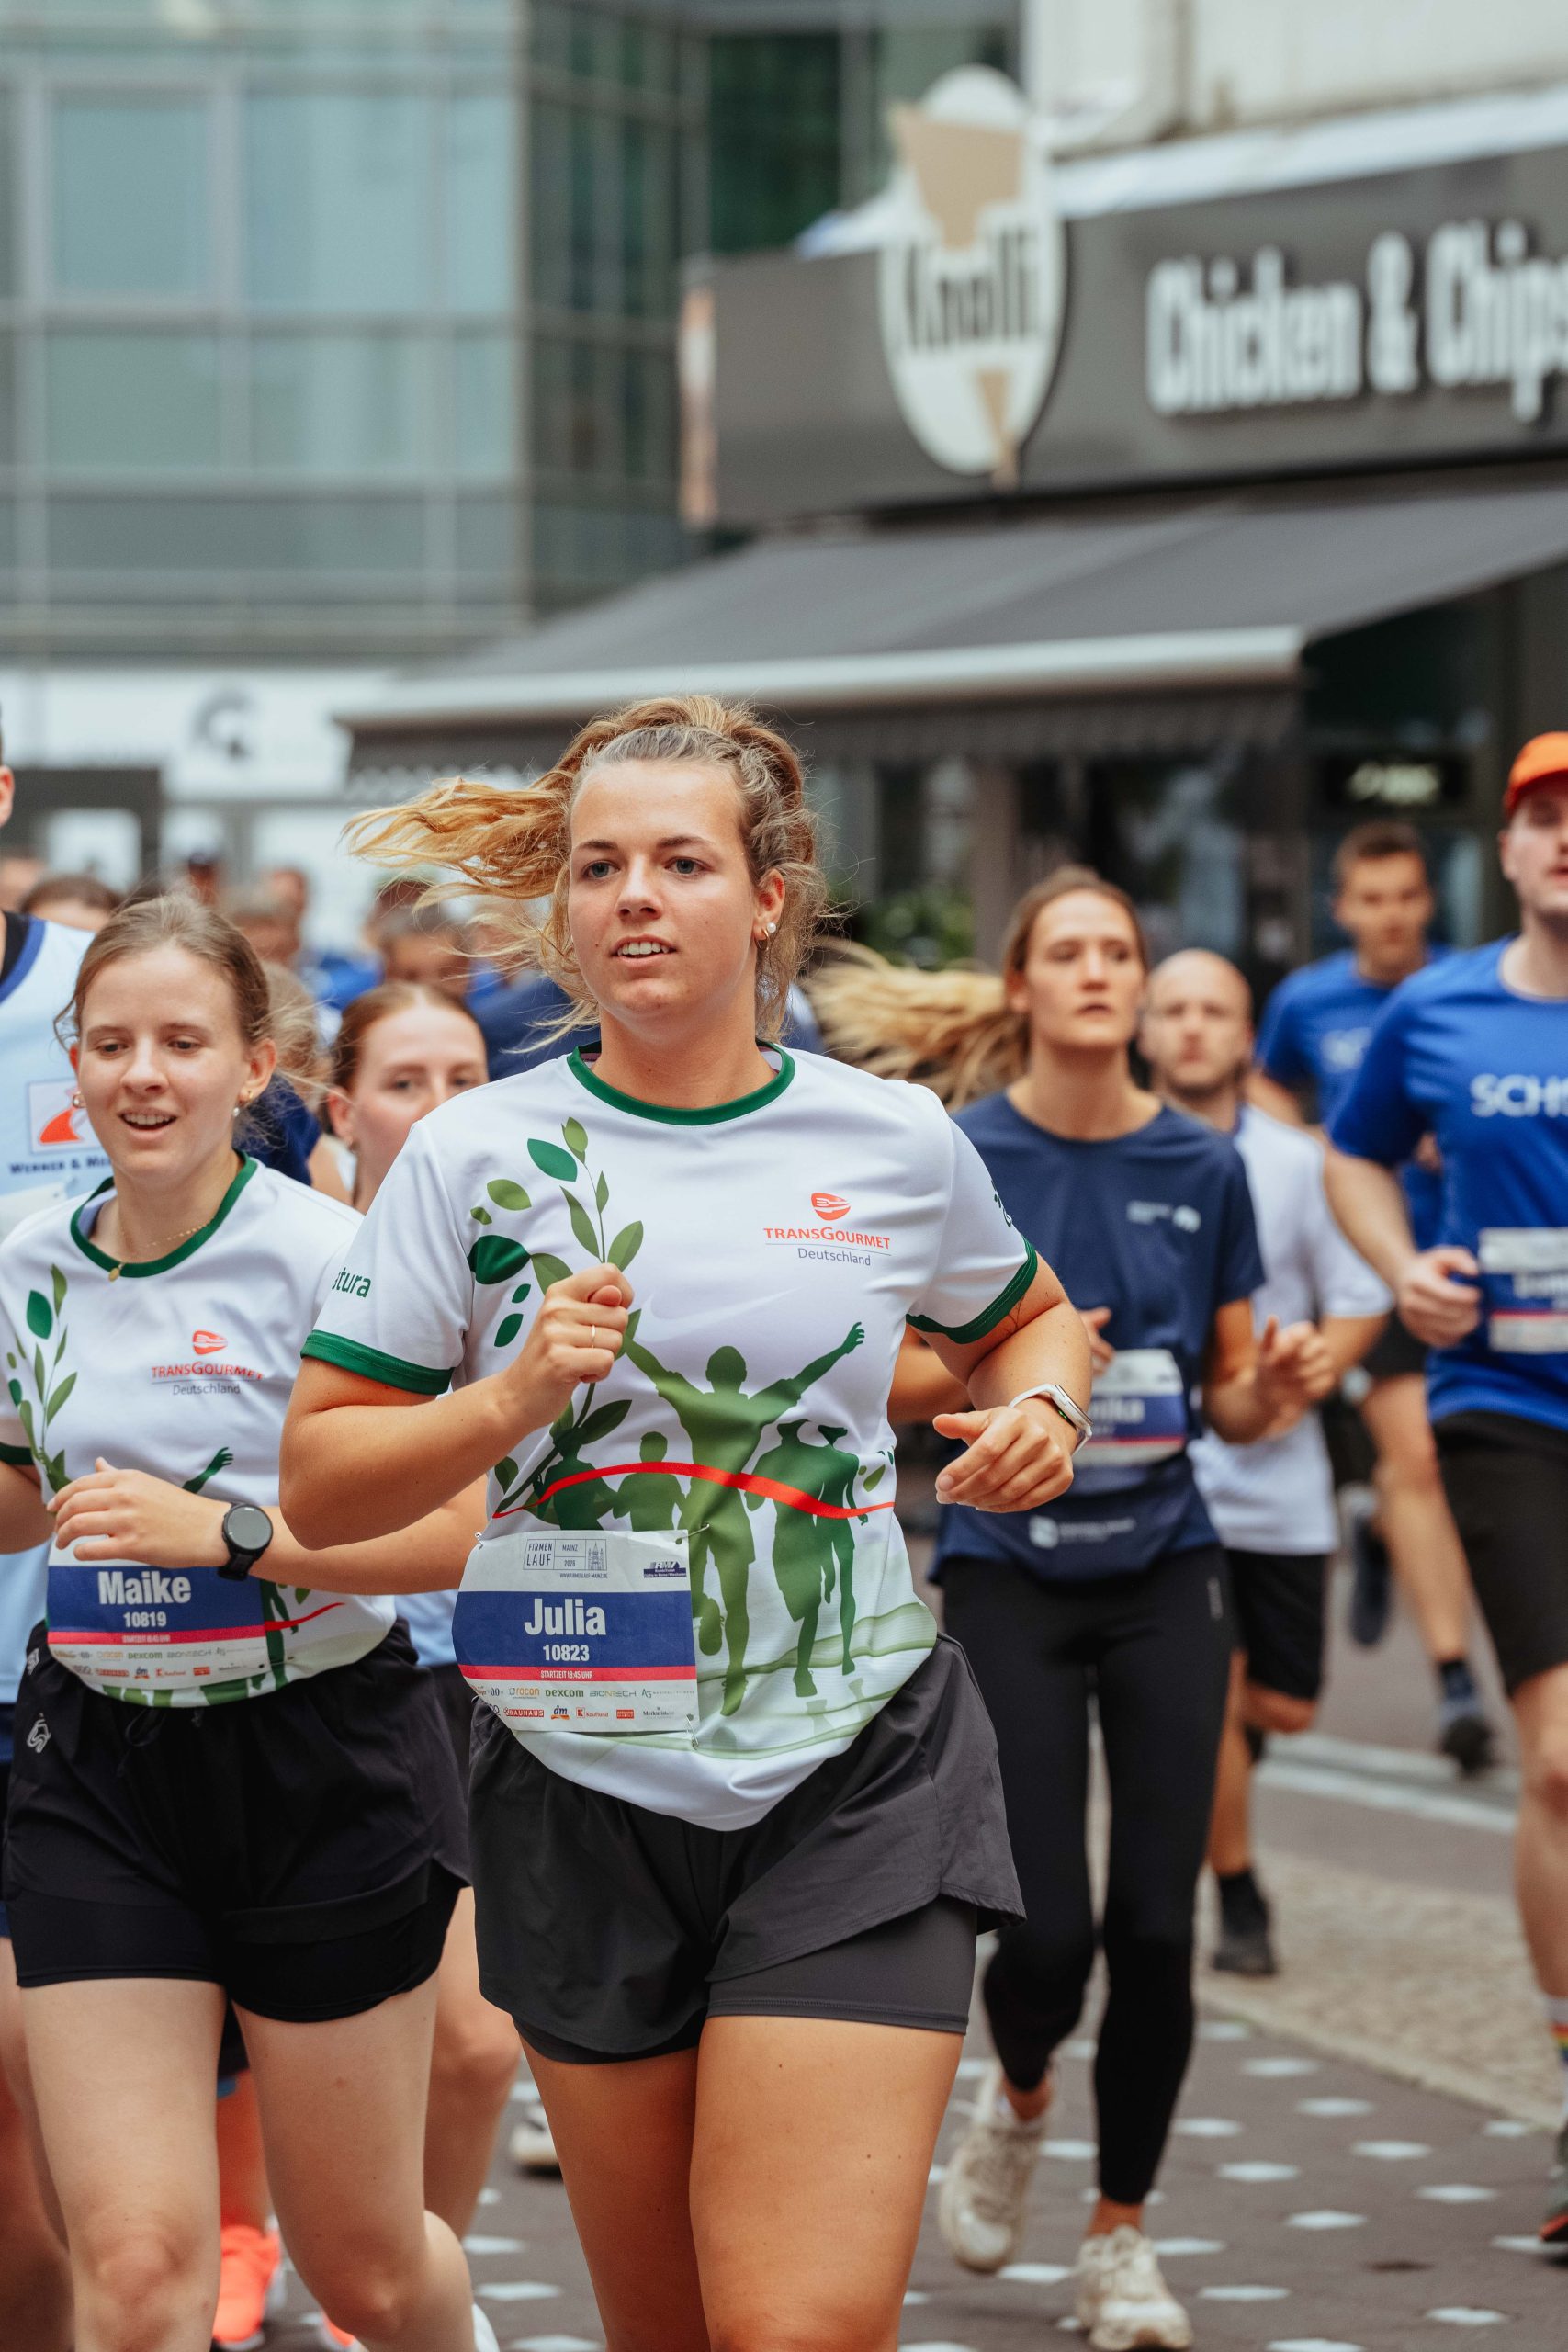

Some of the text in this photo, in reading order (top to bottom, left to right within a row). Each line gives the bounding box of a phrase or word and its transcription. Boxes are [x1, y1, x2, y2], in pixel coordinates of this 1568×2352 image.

[1147, 246, 1363, 415] Chicken
[1368, 230, 1418, 395] &
[1470, 1072, 1568, 1118] SCH
[71, 1157, 81, 1170] &
[797, 1247, 872, 1266] Deutschland
[173, 1382, 242, 1396] Deutschland
[527, 1543, 579, 1553] FIRMEN MAINZ
[526, 1553, 551, 1566] LAUF
[97, 1570, 192, 1605] Maike
[123, 1611, 167, 1628] 10819
[524, 1598, 607, 1636] Julia
[543, 1644, 590, 1662] 10823
[540, 1670, 567, 1679] STARTZEIT
[581, 1670, 593, 1680] UHR
[553, 1705, 568, 1715] dm
